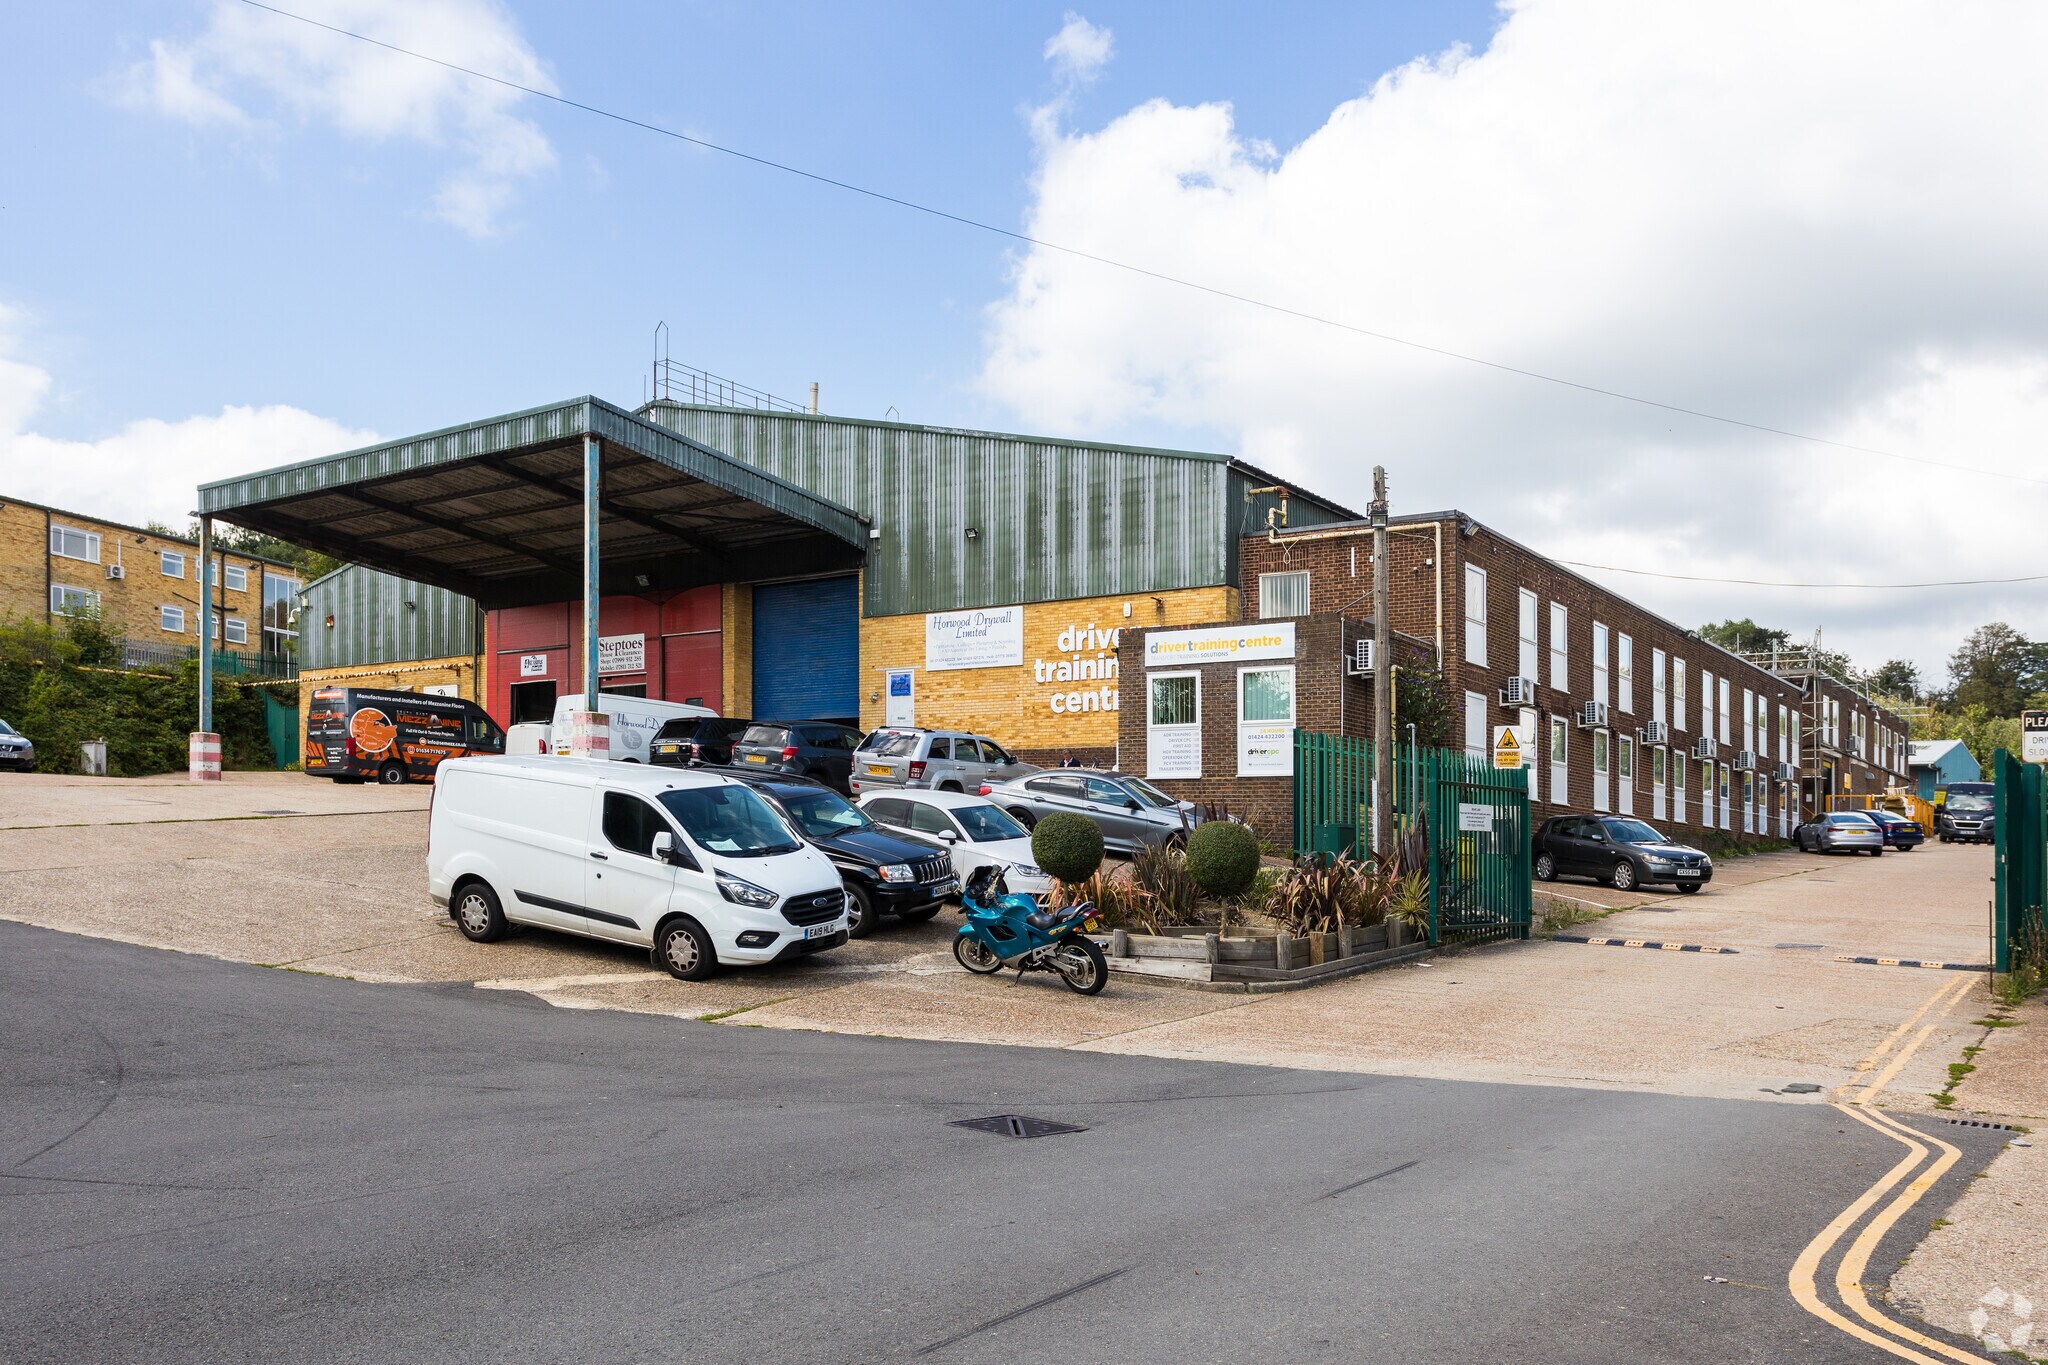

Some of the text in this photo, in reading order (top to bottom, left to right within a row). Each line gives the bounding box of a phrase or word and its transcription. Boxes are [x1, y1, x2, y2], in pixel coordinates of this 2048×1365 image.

[933, 611, 1012, 630] Horwood Drywall
[956, 626, 987, 638] Limited
[1058, 623, 1130, 652] drive
[599, 639, 643, 656] Steptoes
[1150, 635, 1282, 654] drivertrainingcentre
[356, 693, 392, 702] Manufacturers
[396, 713, 462, 729] MEZZANINE
[616, 713, 648, 729] Horwood
